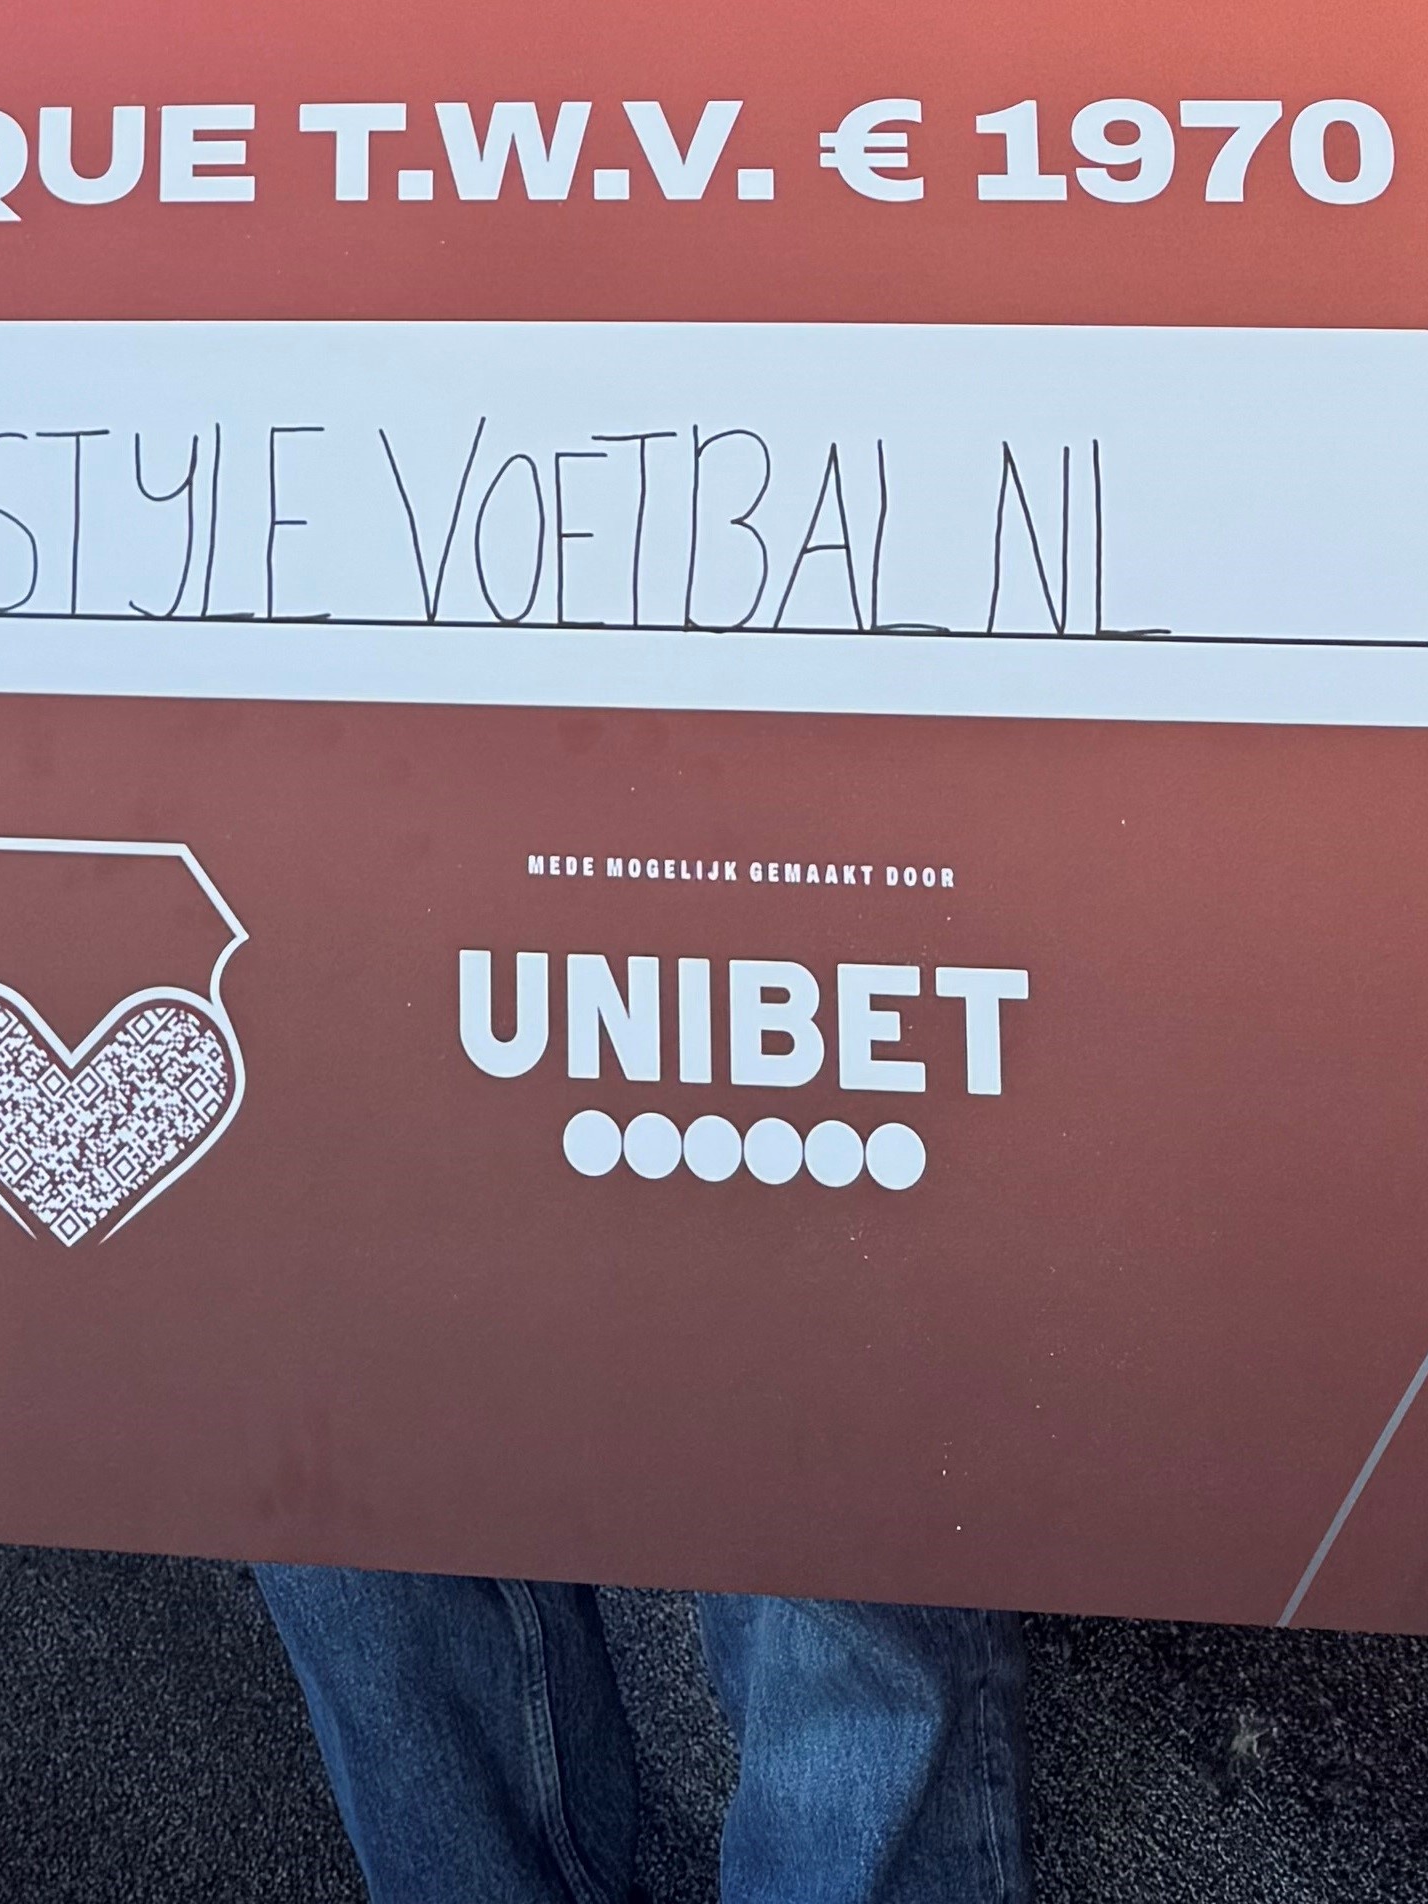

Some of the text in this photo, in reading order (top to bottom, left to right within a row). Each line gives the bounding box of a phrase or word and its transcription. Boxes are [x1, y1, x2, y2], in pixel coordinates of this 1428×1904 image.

[298, 99, 775, 202] T.W.V.
[819, 98, 925, 202] €
[974, 97, 1396, 204] 1970
[380, 415, 950, 634] VOETBAL
[987, 438, 1172, 637] NL
[527, 853, 956, 889] MEDE MOGELIJK GEMAAKT DOOR
[458, 948, 1030, 1097] UNIBET
